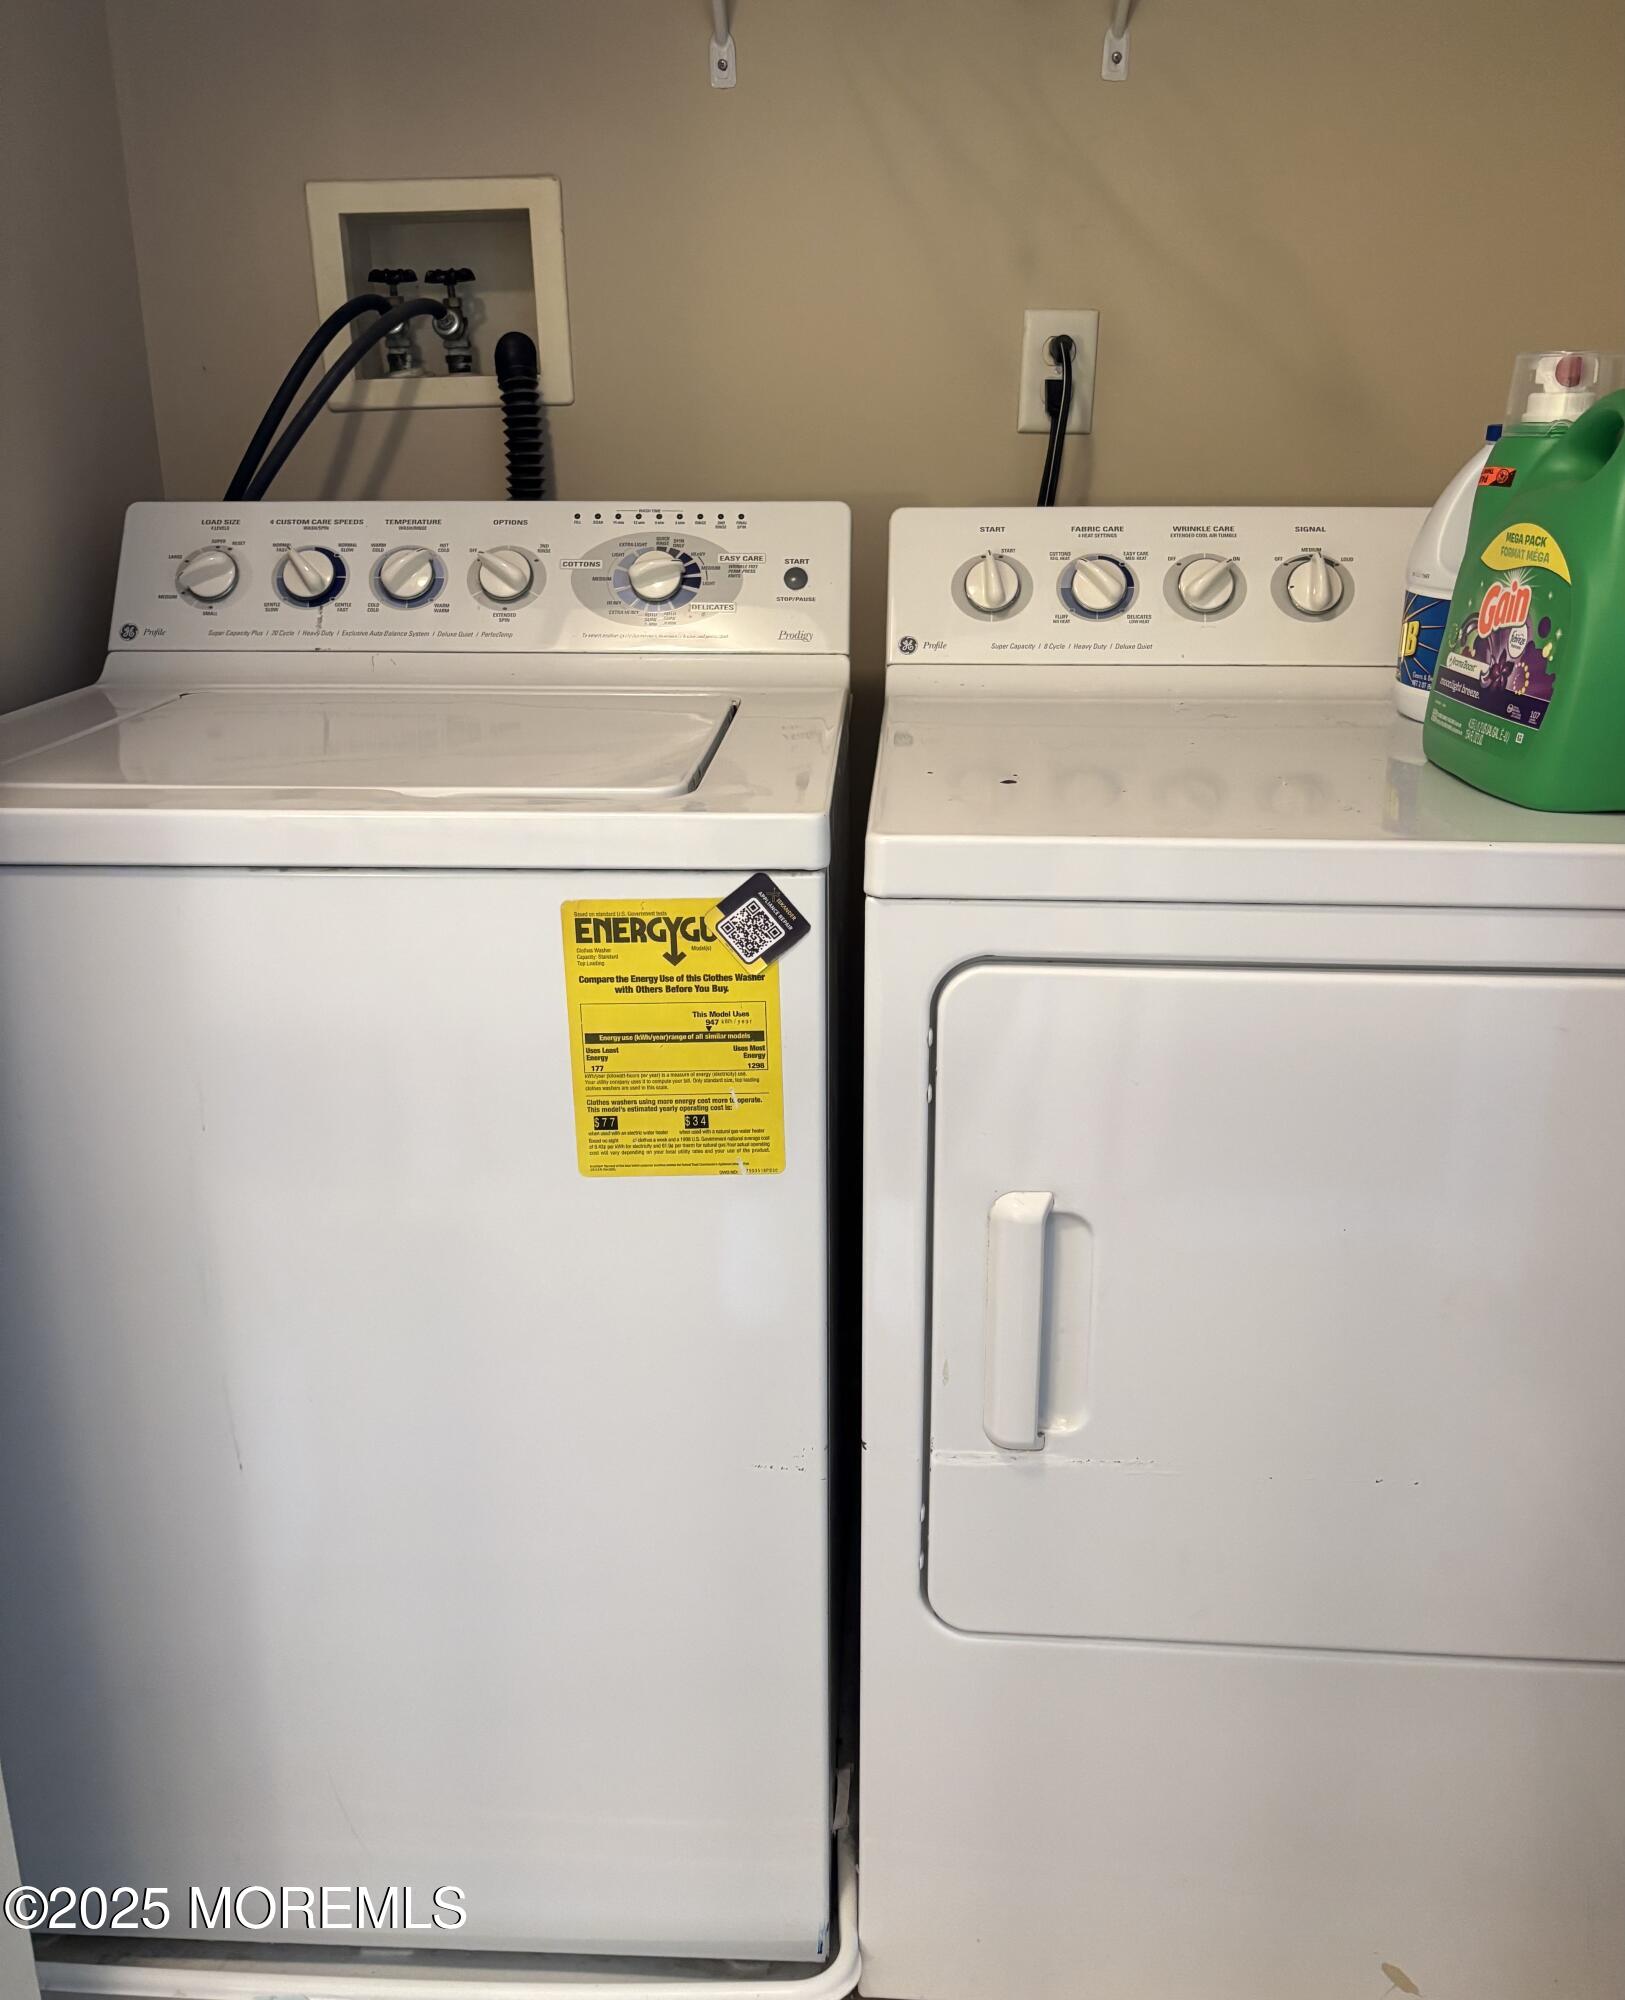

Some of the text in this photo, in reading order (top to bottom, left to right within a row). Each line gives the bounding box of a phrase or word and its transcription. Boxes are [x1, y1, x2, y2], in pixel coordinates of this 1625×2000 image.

[1506, 533, 1547, 547] MEGA PACK
[1501, 546, 1525, 559] FORMAT
[1478, 580, 1531, 636] Gain
[144, 628, 166, 636] Profile
[778, 631, 813, 642] Prodigy
[923, 642, 947, 650] Profile
[1440, 678, 1462, 692] moonlight
[1530, 711, 1540, 719] 107
[758, 892, 793, 930] APPLIANCE REPAIR
[575, 916, 717, 946] ENERGYGU
[579, 976, 614, 984] Compare
[631, 975, 658, 984] Energy
[686, 974, 701, 982] this
[665, 985, 693, 993] Before
[712, 985, 729, 994] Buy.
[595, 1117, 615, 1128] $77
[685, 1116, 706, 1127] $34
